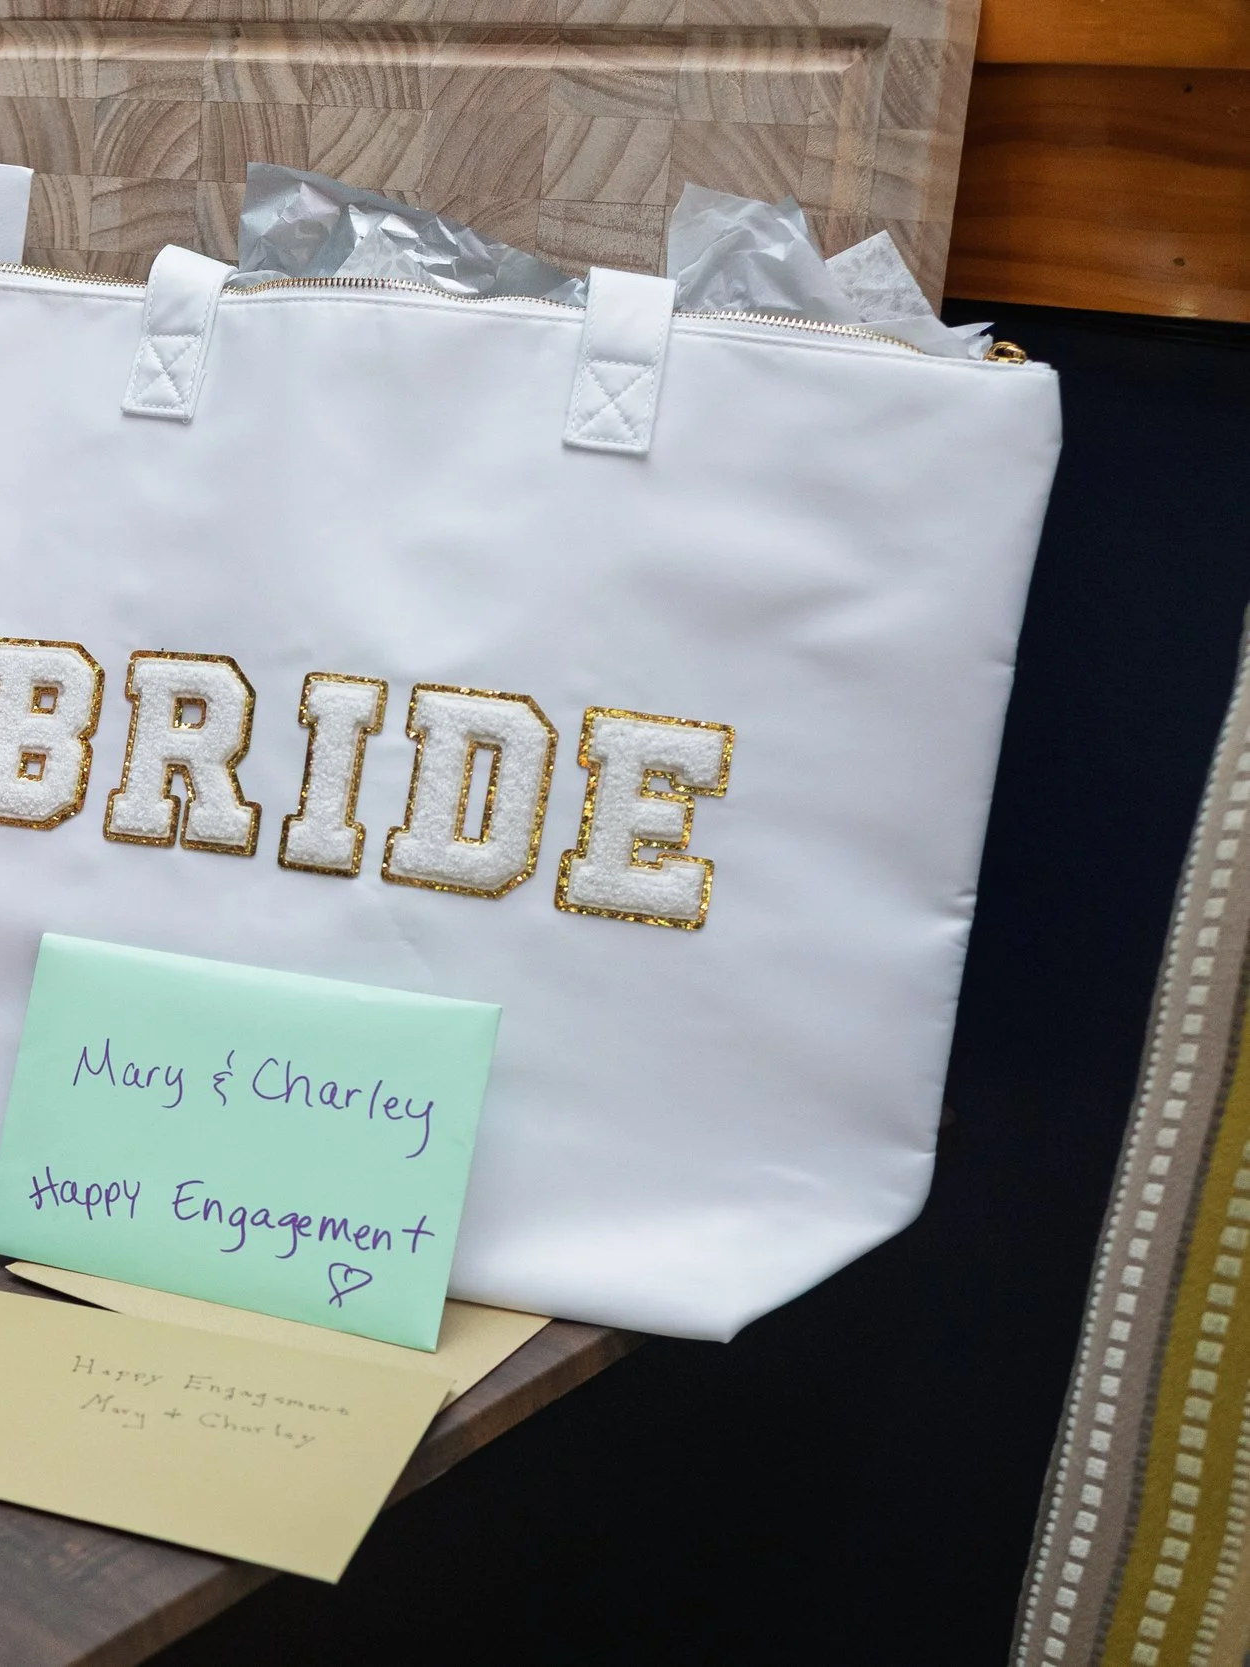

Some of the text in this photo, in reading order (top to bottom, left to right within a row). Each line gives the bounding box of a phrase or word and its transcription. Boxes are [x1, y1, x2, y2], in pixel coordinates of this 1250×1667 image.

[72, 1038, 435, 1159] Mary & Charley
[28, 1165, 436, 1259] Happy Engagement
[71, 1354, 350, 1417] Happy Engagement
[79, 1392, 316, 1450] Mary + Charley
